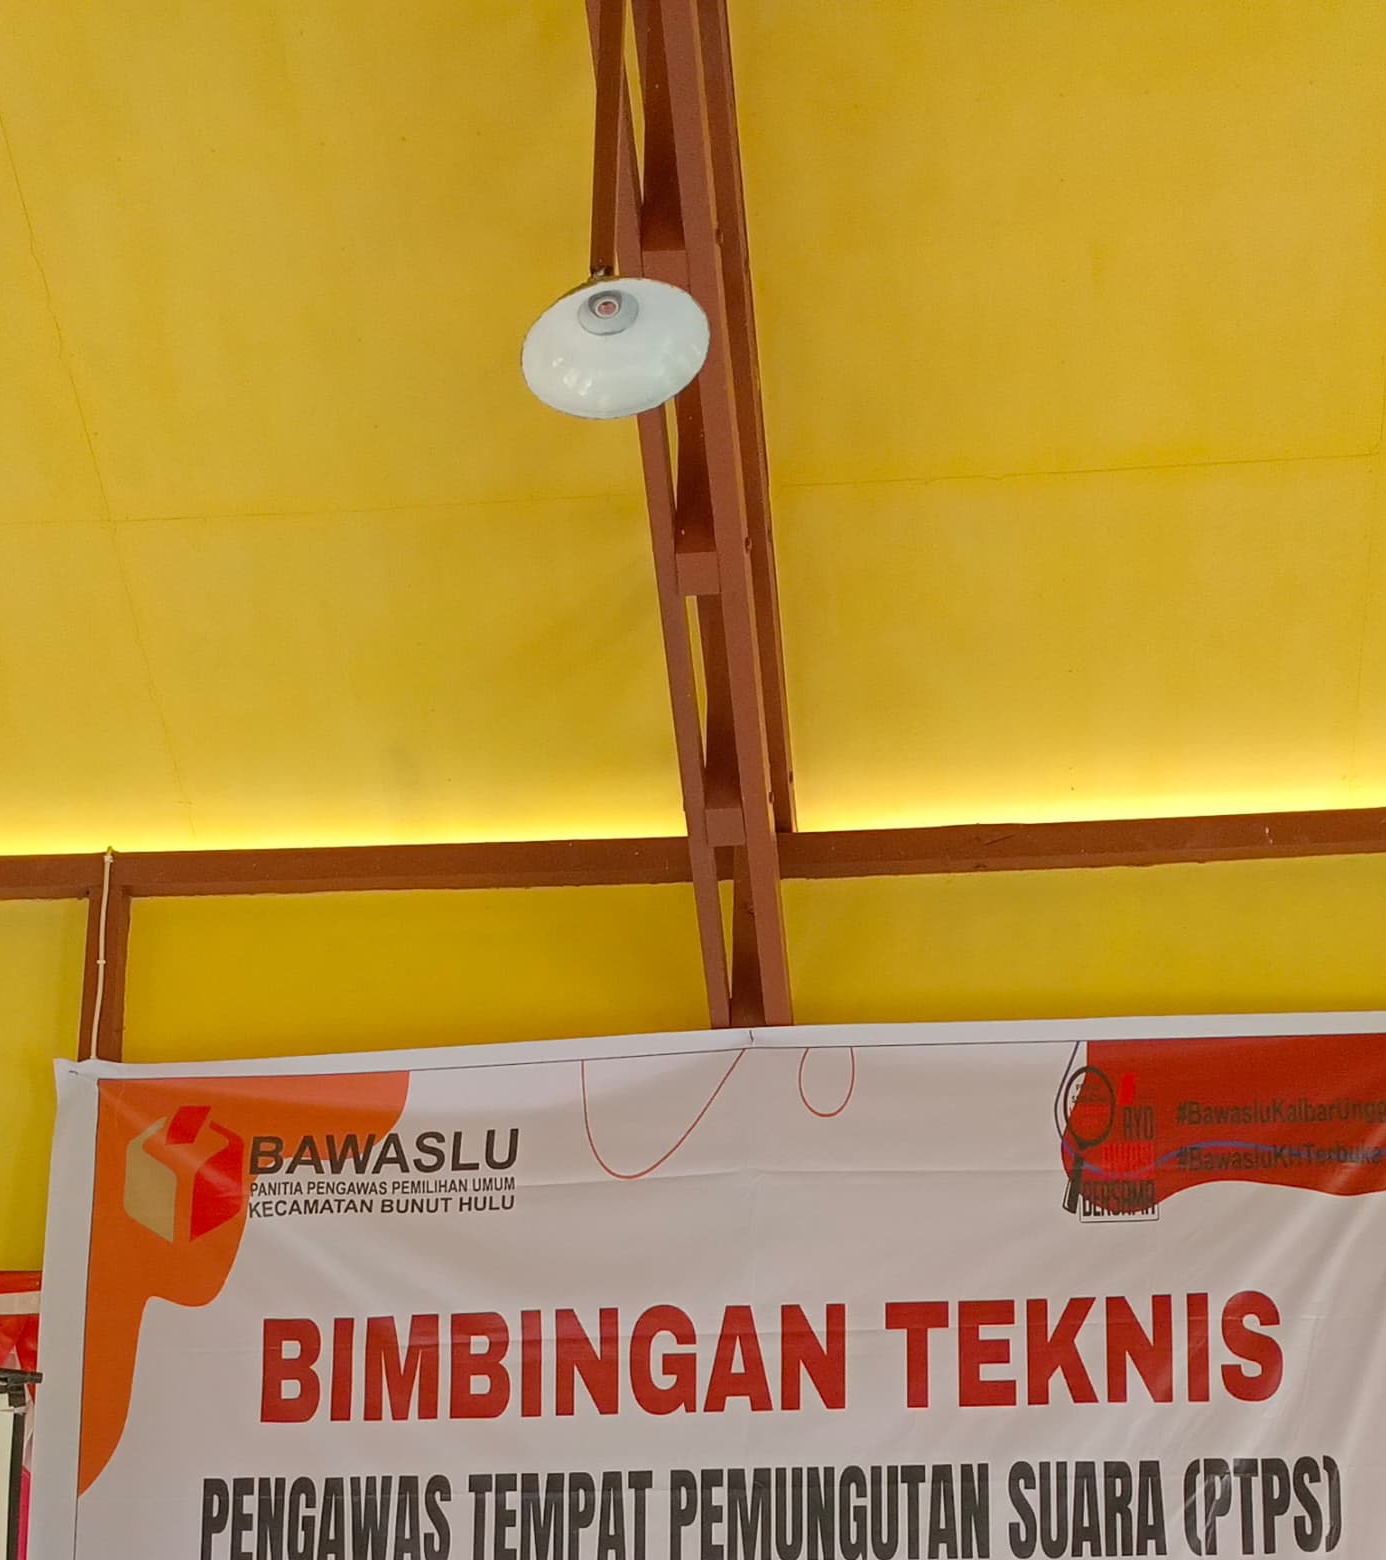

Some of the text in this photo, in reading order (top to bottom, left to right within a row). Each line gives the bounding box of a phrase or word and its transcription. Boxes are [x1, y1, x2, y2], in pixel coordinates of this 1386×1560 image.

[249, 1127, 520, 1176] BAWASLU
[248, 1194, 515, 1219] KECAMATAN BUNUT HULU
[250, 1176, 515, 1197] PANITIA PENGAWAS PEMILIHAN UMUM
[260, 1291, 1284, 1423] BIMBINGAN TEKNIS
[1007, 1460, 1168, 1559] SUARA
[1183, 1455, 1342, 1556] (PTPS)
